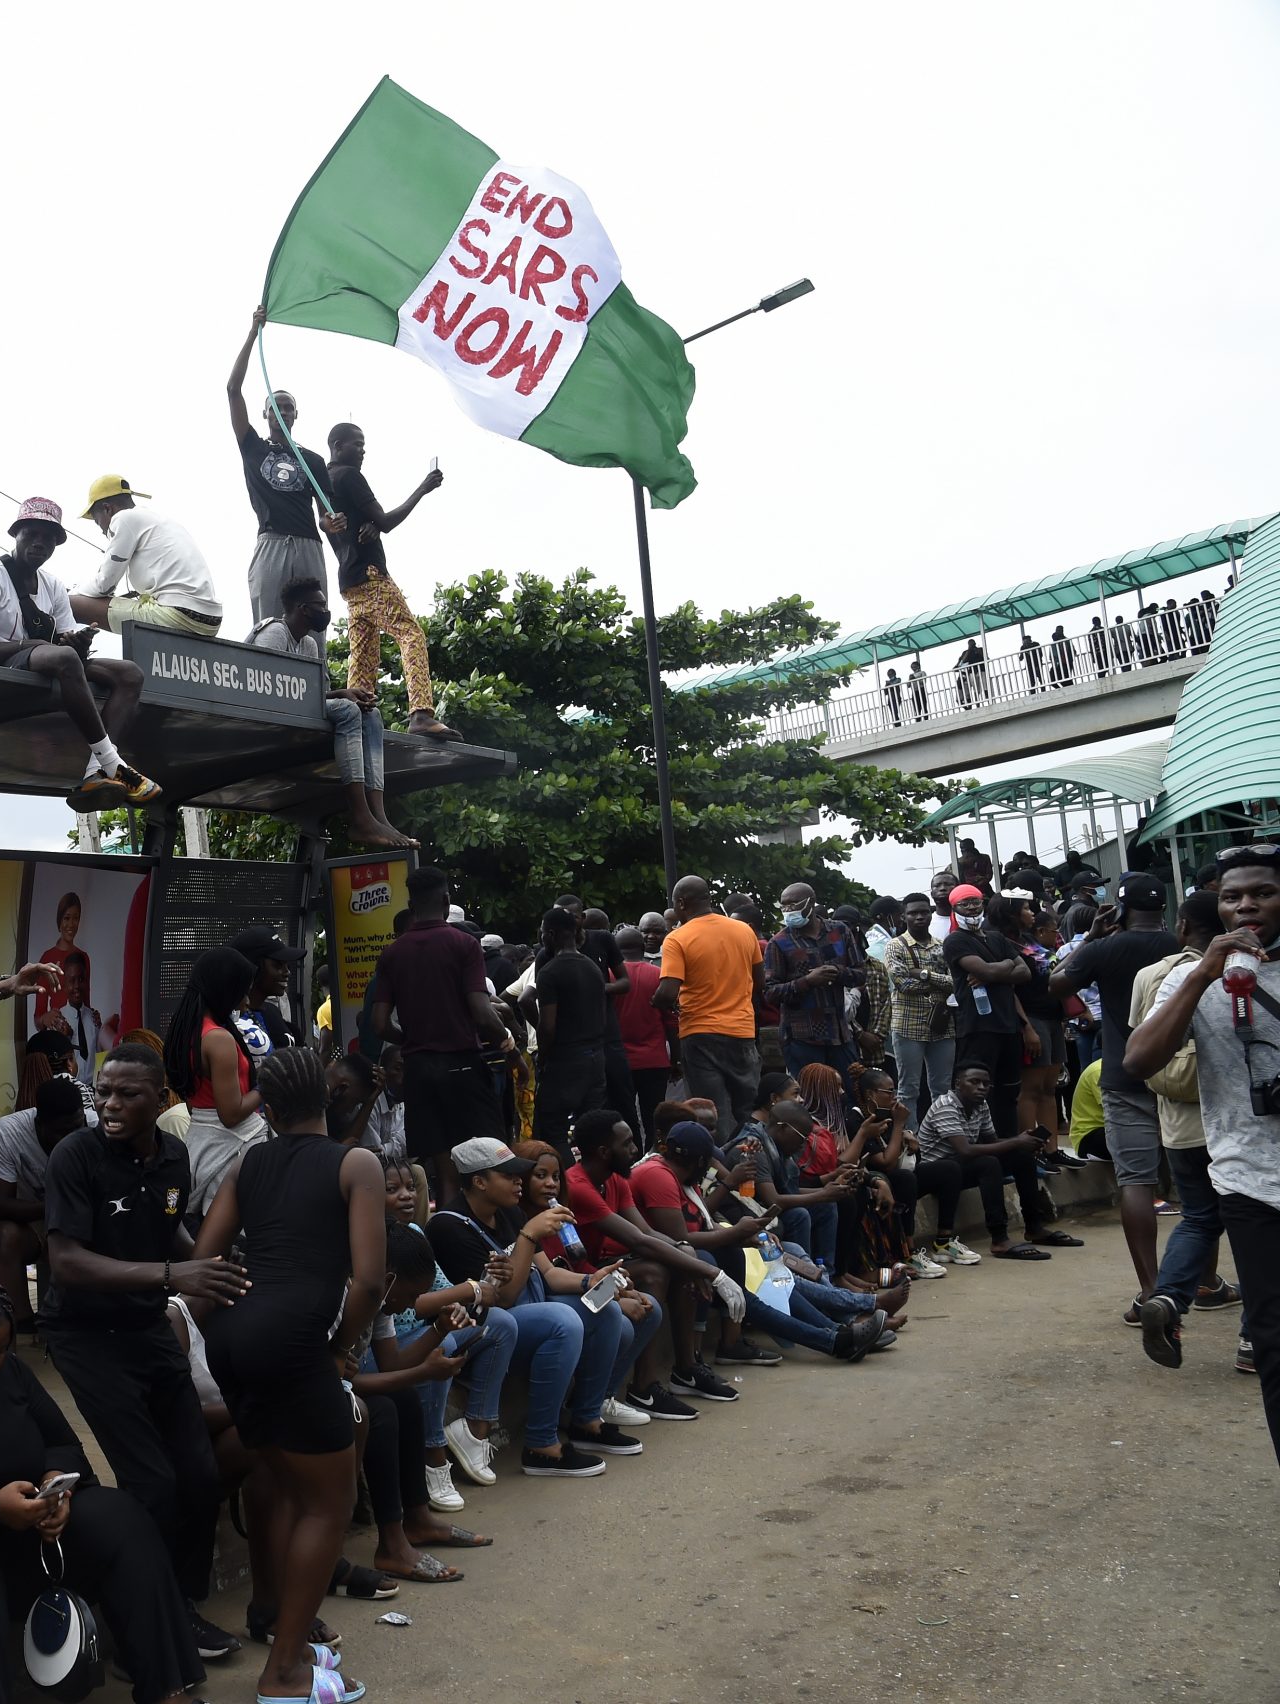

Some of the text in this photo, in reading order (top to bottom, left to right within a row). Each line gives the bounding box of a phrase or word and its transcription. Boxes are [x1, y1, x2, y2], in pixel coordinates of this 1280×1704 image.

[480, 172, 573, 239] END
[448, 218, 599, 323] SARS
[412, 280, 566, 397] NOW
[151, 651, 307, 700] ALAUSA SEC. BUS STOP
[351, 895, 390, 912] Crowns
[359, 886, 388, 903] Three
[367, 934, 384, 942] why
[345, 955, 360, 963] like
[347, 981, 358, 989] do
[1237, 996, 1246, 1018] anon
